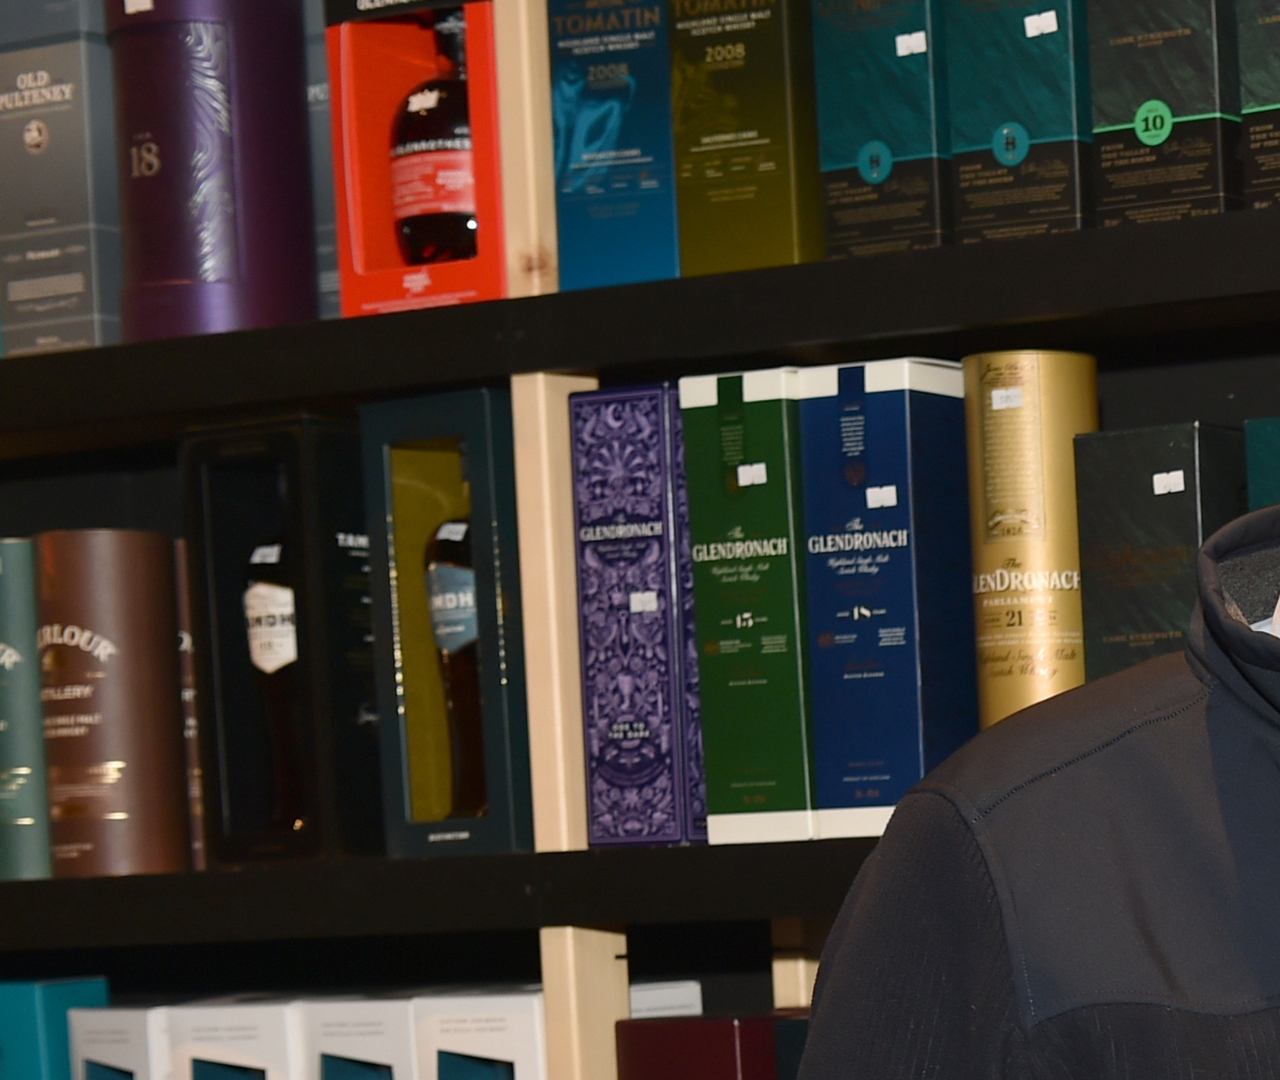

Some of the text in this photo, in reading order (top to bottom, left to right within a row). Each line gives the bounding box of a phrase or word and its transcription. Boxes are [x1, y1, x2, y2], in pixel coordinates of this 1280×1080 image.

[552, 6, 661, 36] TOMATIN
[705, 42, 746, 62] 2008
[16, 70, 49, 90] OLD
[1141, 115, 1164, 133] 10
[131, 142, 161, 178] 18
[580, 521, 663, 542] GLENDRONACH
[808, 529, 908, 554] GLENDRONACH
[692, 537, 788, 562] GLENDRONACH
[1001, 557, 1022, 568] The
[1005, 610, 1023, 627] 21
